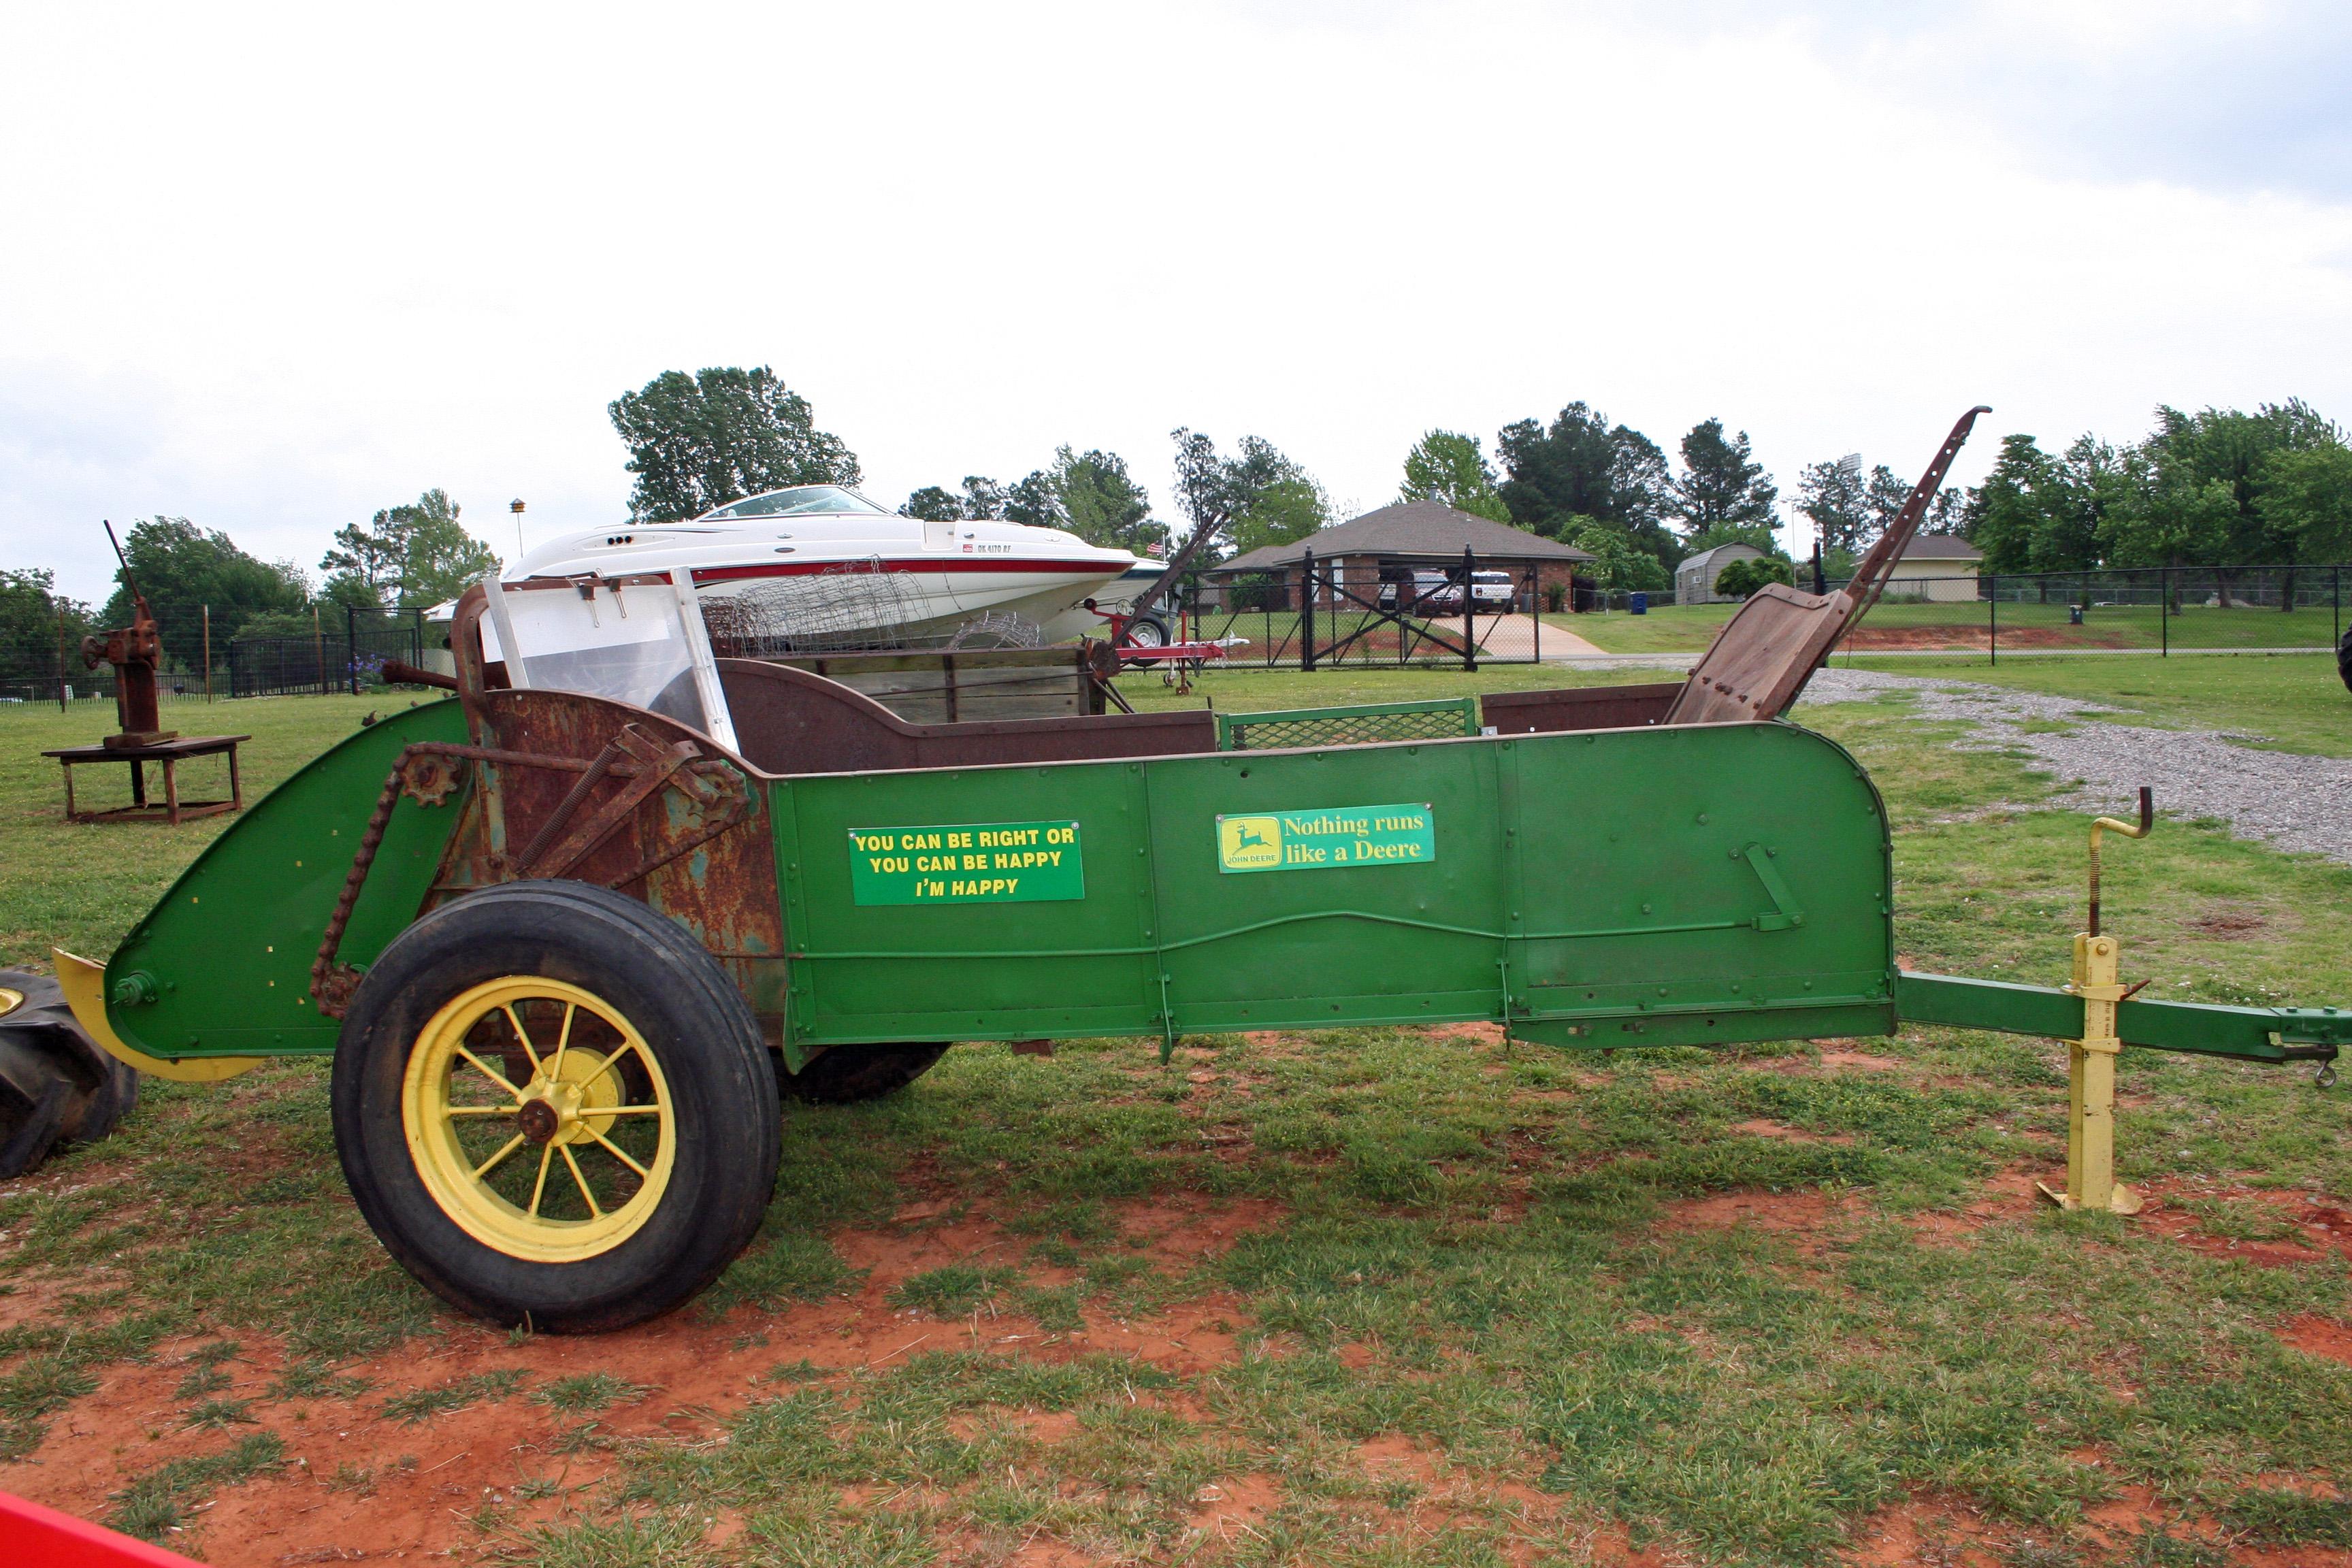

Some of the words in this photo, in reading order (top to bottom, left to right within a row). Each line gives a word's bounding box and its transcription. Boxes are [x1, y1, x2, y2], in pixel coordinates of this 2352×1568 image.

[1284, 815, 1368, 837] Nothing
[1375, 815, 1423, 832] runs
[856, 836, 894, 851] YOU
[902, 834, 941, 849] CAN
[948, 832, 972, 848] BE
[980, 830, 1039, 847] RIGHT
[1047, 828, 1074, 844] OR
[870, 858, 909, 873] YOU
[917, 856, 956, 871] CAN
[964, 855, 987, 870] BE
[995, 851, 1062, 868] HAPPY
[1251, 854, 1276, 862] DEERE
[1286, 844, 1326, 864] like
[1335, 847, 1348, 861] a
[1355, 840, 1420, 860] Deere
[952, 879, 1018, 896] HAPPY
